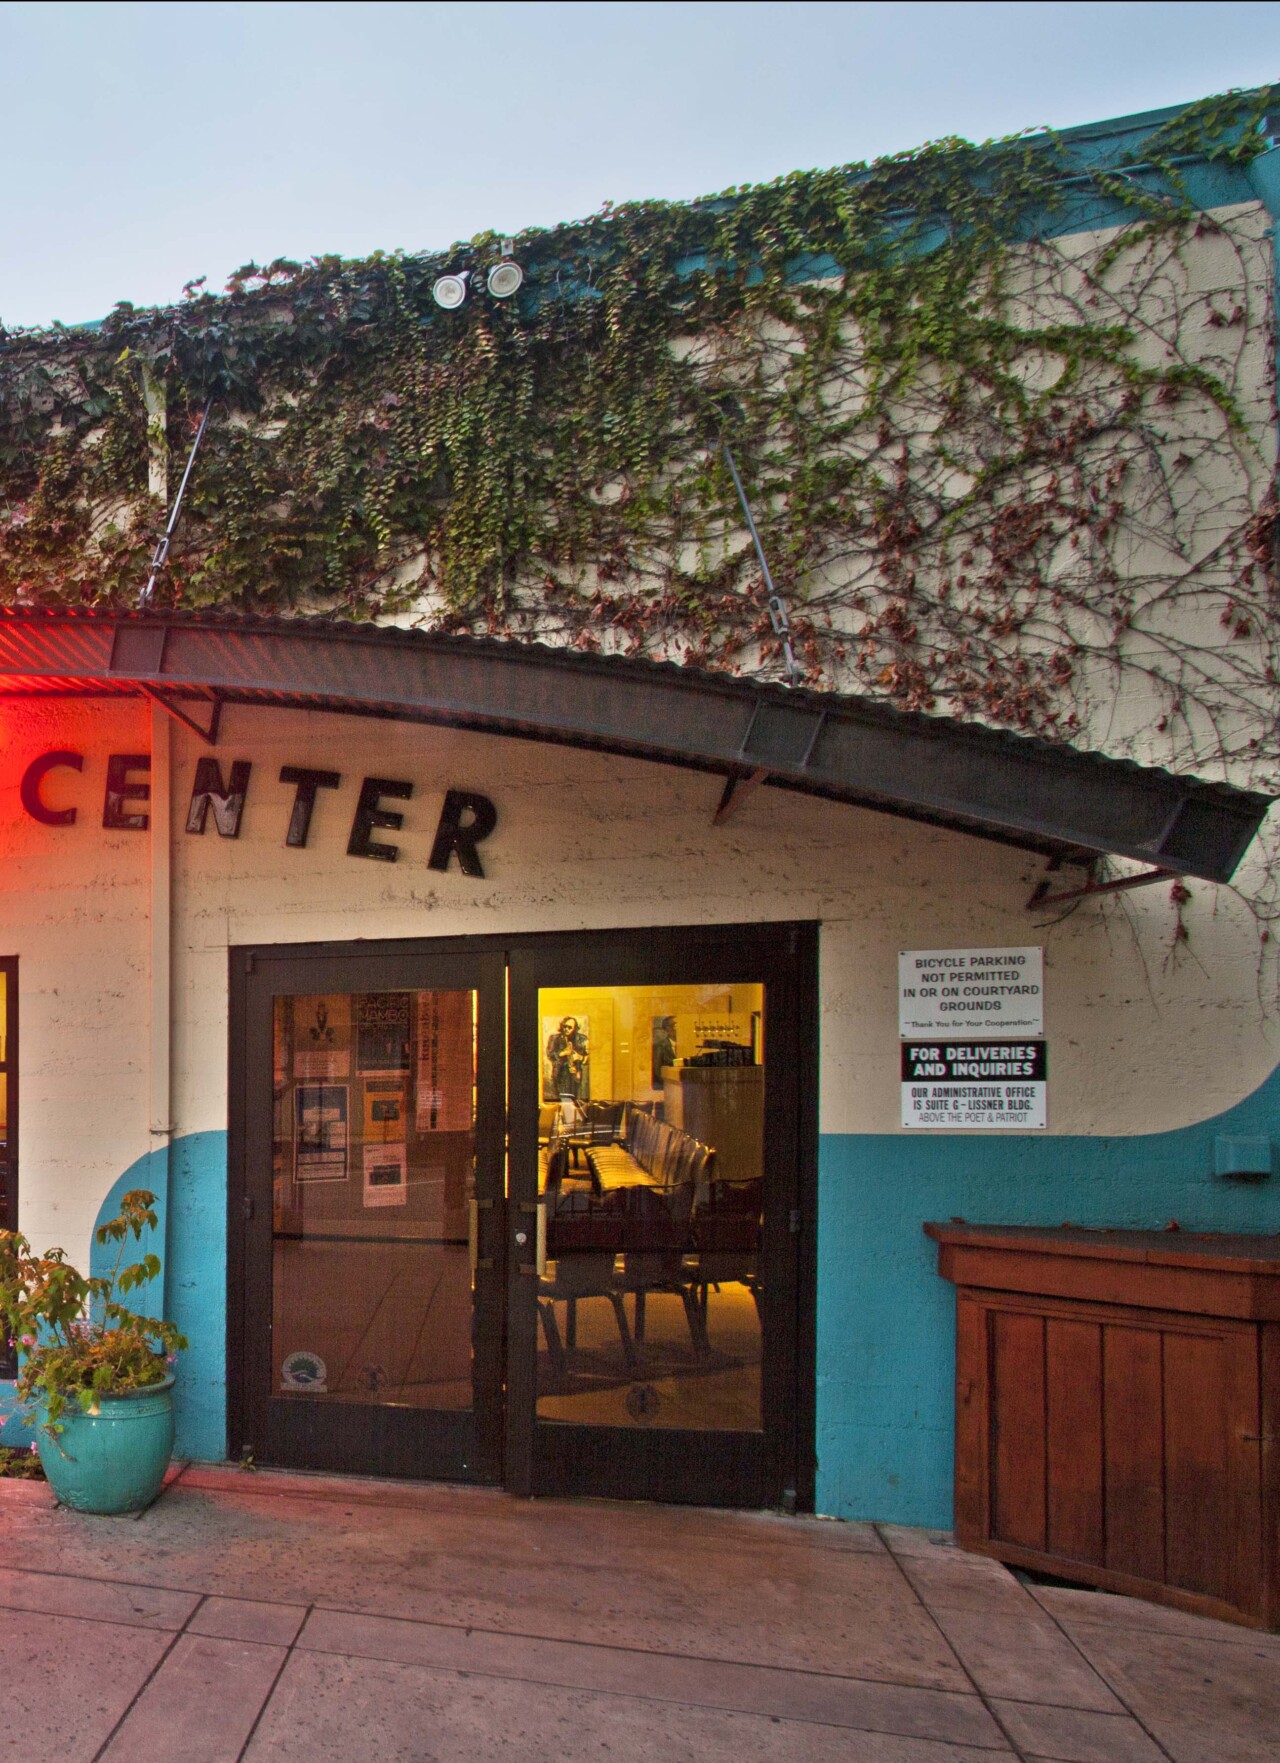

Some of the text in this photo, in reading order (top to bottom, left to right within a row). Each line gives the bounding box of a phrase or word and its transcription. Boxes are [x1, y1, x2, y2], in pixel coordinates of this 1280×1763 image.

[20, 750, 498, 878] CENTER
[915, 955, 1026, 968] BICYCLE PARKING
[921, 971, 1020, 983] NOT PERMITTED
[903, 985, 1039, 998] IN OR ON COURTYARD
[939, 1001, 1002, 1011] GROUNDS
[910, 1046, 1036, 1061] FOR DELIVERIES
[913, 1062, 1034, 1078] AND INQUIRIES
[911, 1087, 1035, 1098] OUR ADMINISTRATIVE OFFICE
[913, 1100, 922, 1110] IS
[925, 1100, 949, 1110] SUITE
[952, 1100, 959, 1110] G
[968, 1100, 1004, 1110] LISSNER
[1007, 1100, 1033, 1110] BLDG.
[918, 1112, 1028, 1122] ABOVE THE POET & PATRIOT
